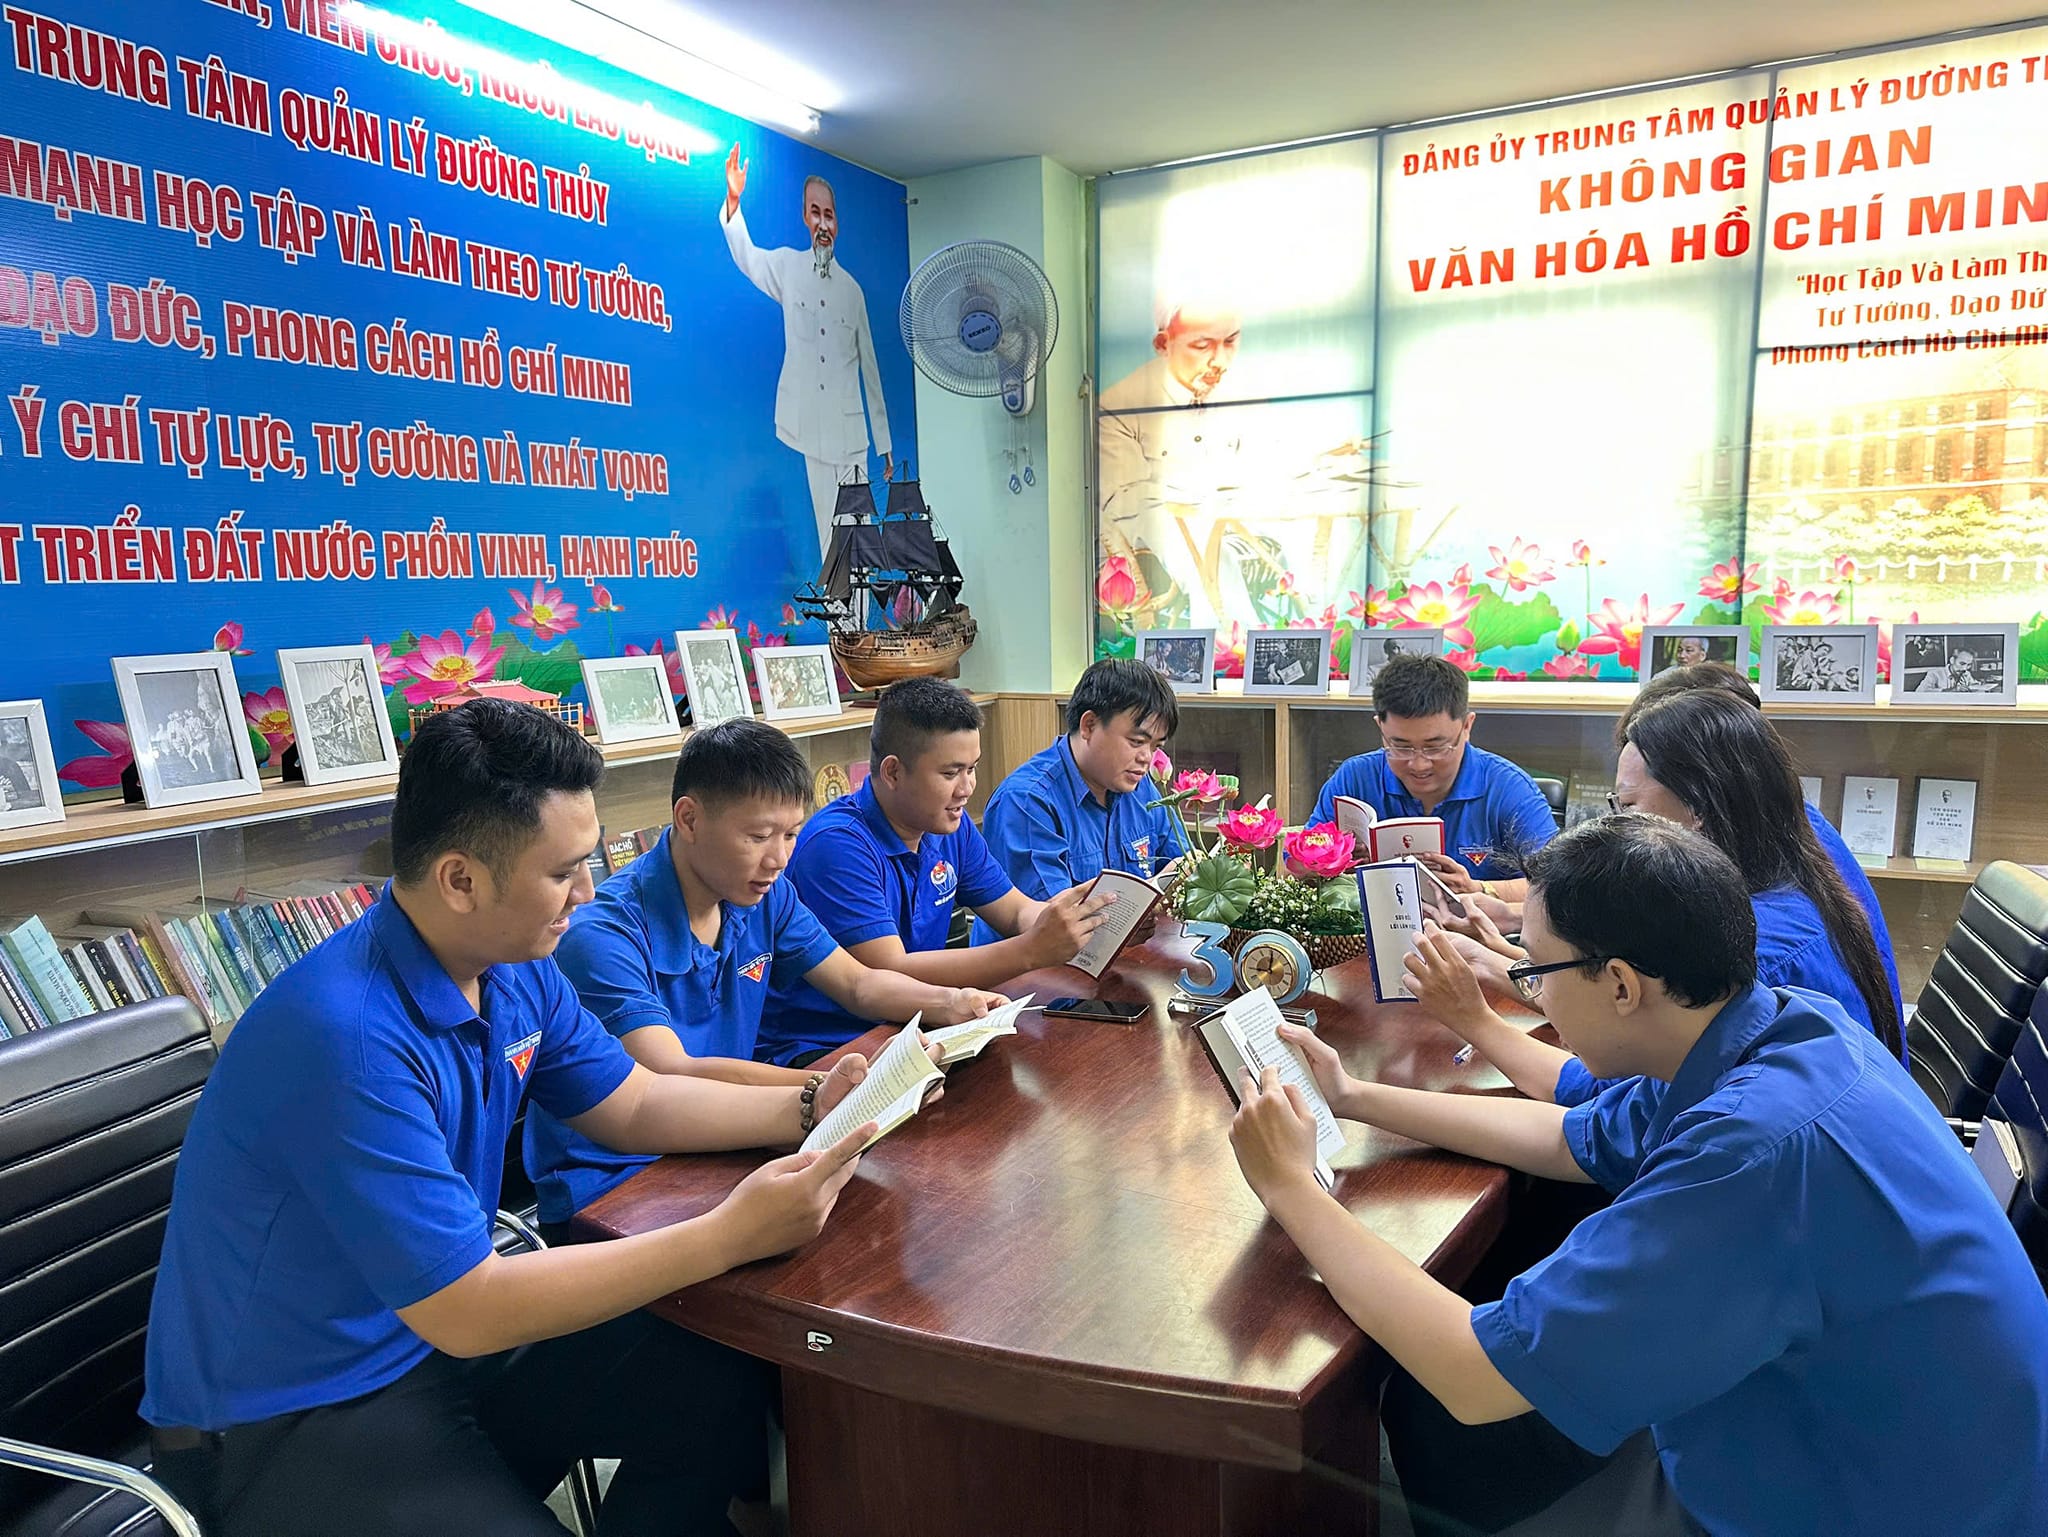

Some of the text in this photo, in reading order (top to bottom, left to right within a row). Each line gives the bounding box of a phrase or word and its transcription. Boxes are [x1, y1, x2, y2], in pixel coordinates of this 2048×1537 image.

[4, 6, 609, 225] TRUNG TÂM QUẢN LÝ ĐƯỜNG THỦY
[1403, 143, 1479, 176] ĐẢNG
[1490, 133, 1525, 163] ỦY
[1535, 120, 1636, 156] TRUNG
[1646, 107, 1714, 139] TÂM
[1726, 87, 1818, 129] QUẢN
[1830, 78, 1869, 112] LÝ
[1880, 64, 2008, 104] ĐƯỜNG
[1539, 125, 1932, 214] KHÔNG GIAN
[0, 134, 672, 332] MẠNH HỌC TẬP VÀ LÀM THEO TƯ TƯỞNG,
[1408, 246, 1514, 292] VĂN
[1535, 229, 1650, 278] HÓA
[1671, 205, 1751, 263] HỒ
[1773, 192, 1884, 251] CHÍ
[1857, 267, 1901, 291] Tập
[1911, 262, 1943, 284] Và
[1952, 257, 2007, 279] Làm
[107, 276, 216, 359] ĐỨC,
[224, 300, 358, 371] PHONG
[365, 318, 455, 383] CÁCH
[461, 327, 502, 389] HỒ
[510, 343, 557, 396] CHÍ
[562, 354, 632, 406] MINH
[1816, 307, 1846, 327] Tư
[1950, 295, 2000, 317] Đạo
[8, 384, 669, 501] Ý CHÍ TỰ LỰC, TỰ CƯỜNG VÀ KHÁT VỌNG
[33, 504, 177, 582] TRIỂN
[184, 510, 263, 582] ĐẤT
[272, 520, 375, 581] NƯỚC
[383, 516, 473, 578] PHỒN
[478, 534, 555, 582] VINH,
[561, 535, 632, 586] HẠNH
[636, 531, 697, 578] PHÚC
